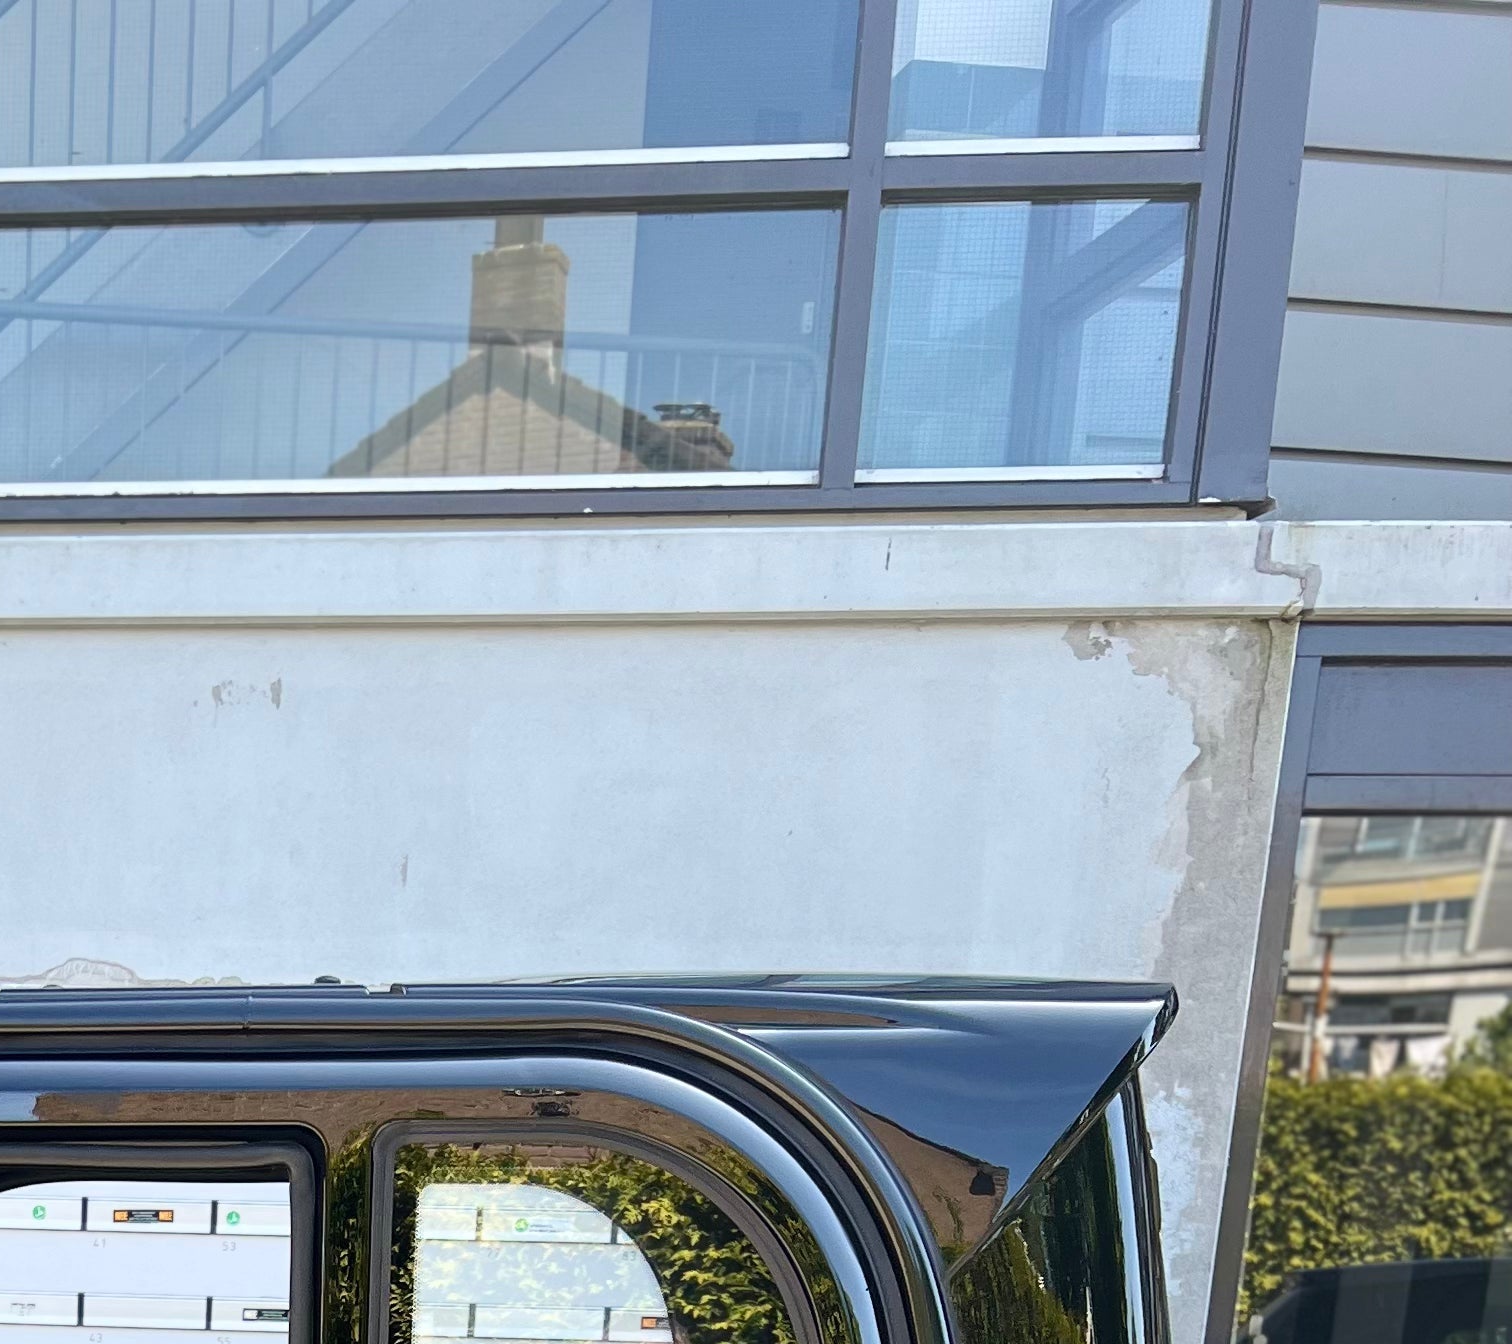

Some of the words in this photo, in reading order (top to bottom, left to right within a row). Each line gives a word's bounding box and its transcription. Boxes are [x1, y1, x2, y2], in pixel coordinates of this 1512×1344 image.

[93, 1237, 106, 1248] 41
[222, 1241, 237, 1252] 53
[89, 1333, 103, 1344] 43
